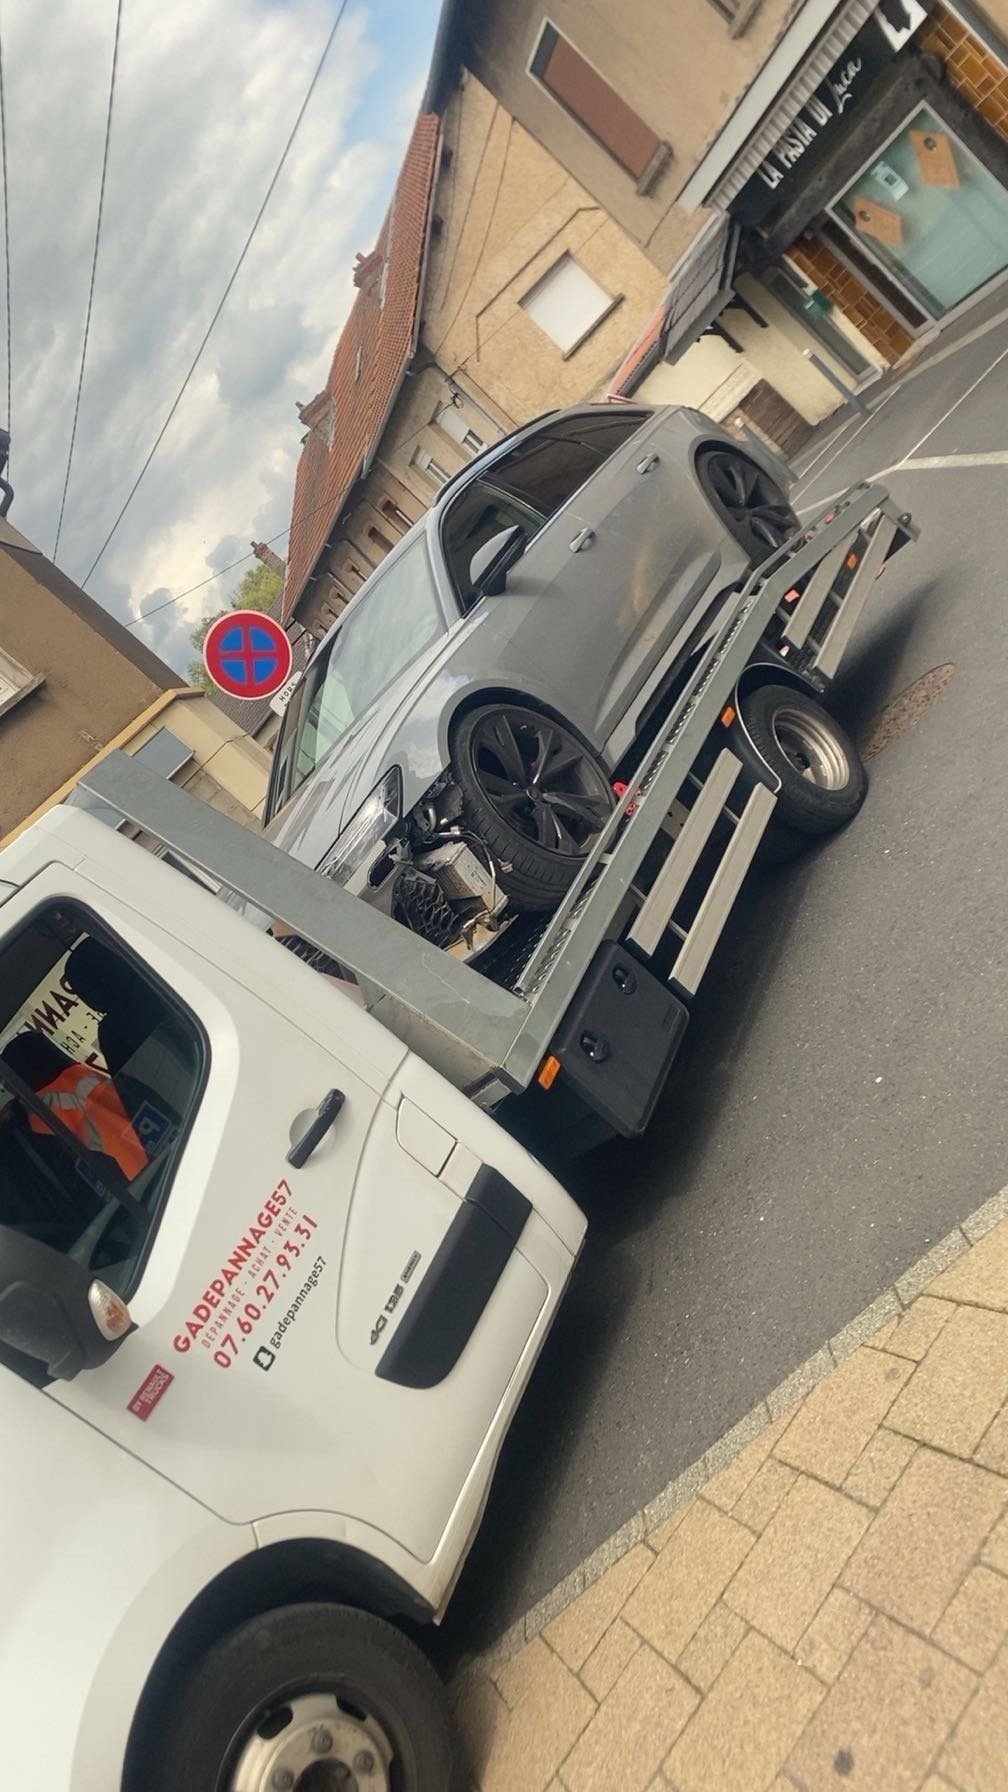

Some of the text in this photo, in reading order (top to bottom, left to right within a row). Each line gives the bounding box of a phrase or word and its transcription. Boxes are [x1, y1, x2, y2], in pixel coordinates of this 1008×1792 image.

[756, 158, 784, 190] LA
[825, 57, 862, 115] Luca
[173, 1178, 293, 1353] GADEPANNAGE57
[201, 1206, 298, 1349] DÉPANNAGE ACHAT VENTE
[213, 1214, 318, 1369] 07.60.27.93.31
[269, 1255, 327, 1350] gadepannage57
